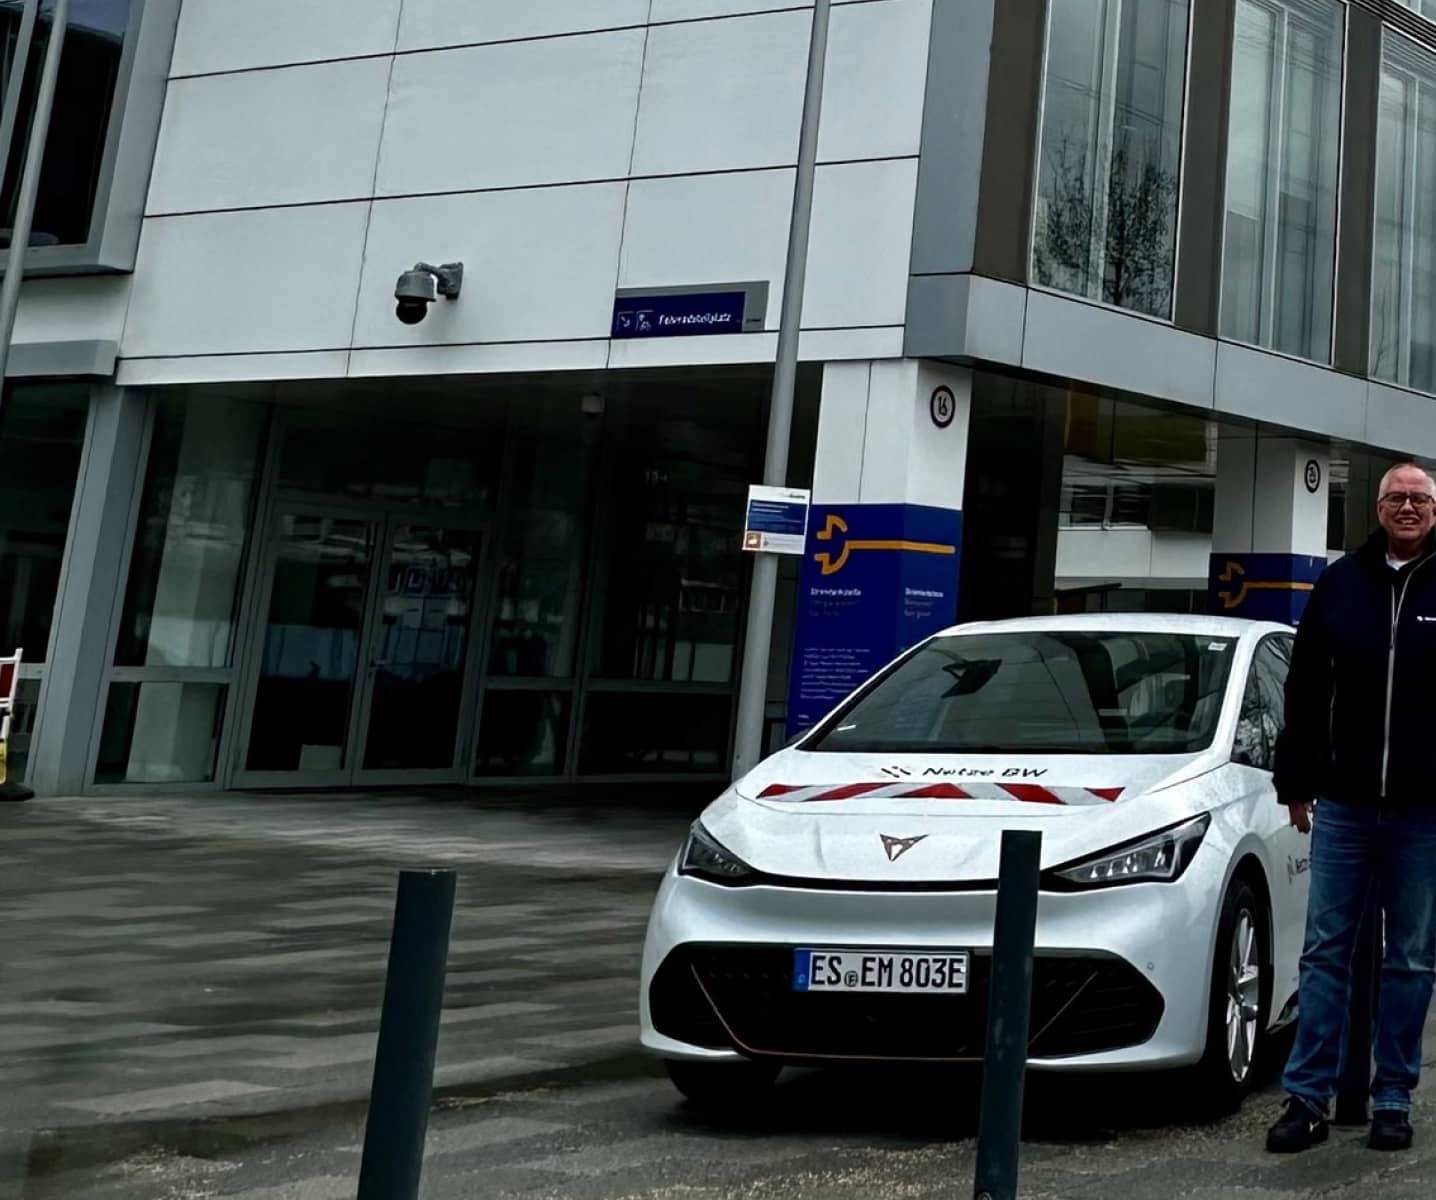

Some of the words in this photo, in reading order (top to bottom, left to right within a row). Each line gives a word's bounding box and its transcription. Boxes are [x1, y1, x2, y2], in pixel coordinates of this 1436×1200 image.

[1001, 767, 1048, 778] BW
[811, 954, 842, 985] ES
[861, 956, 894, 988] EM
[899, 957, 964, 989] 803E
